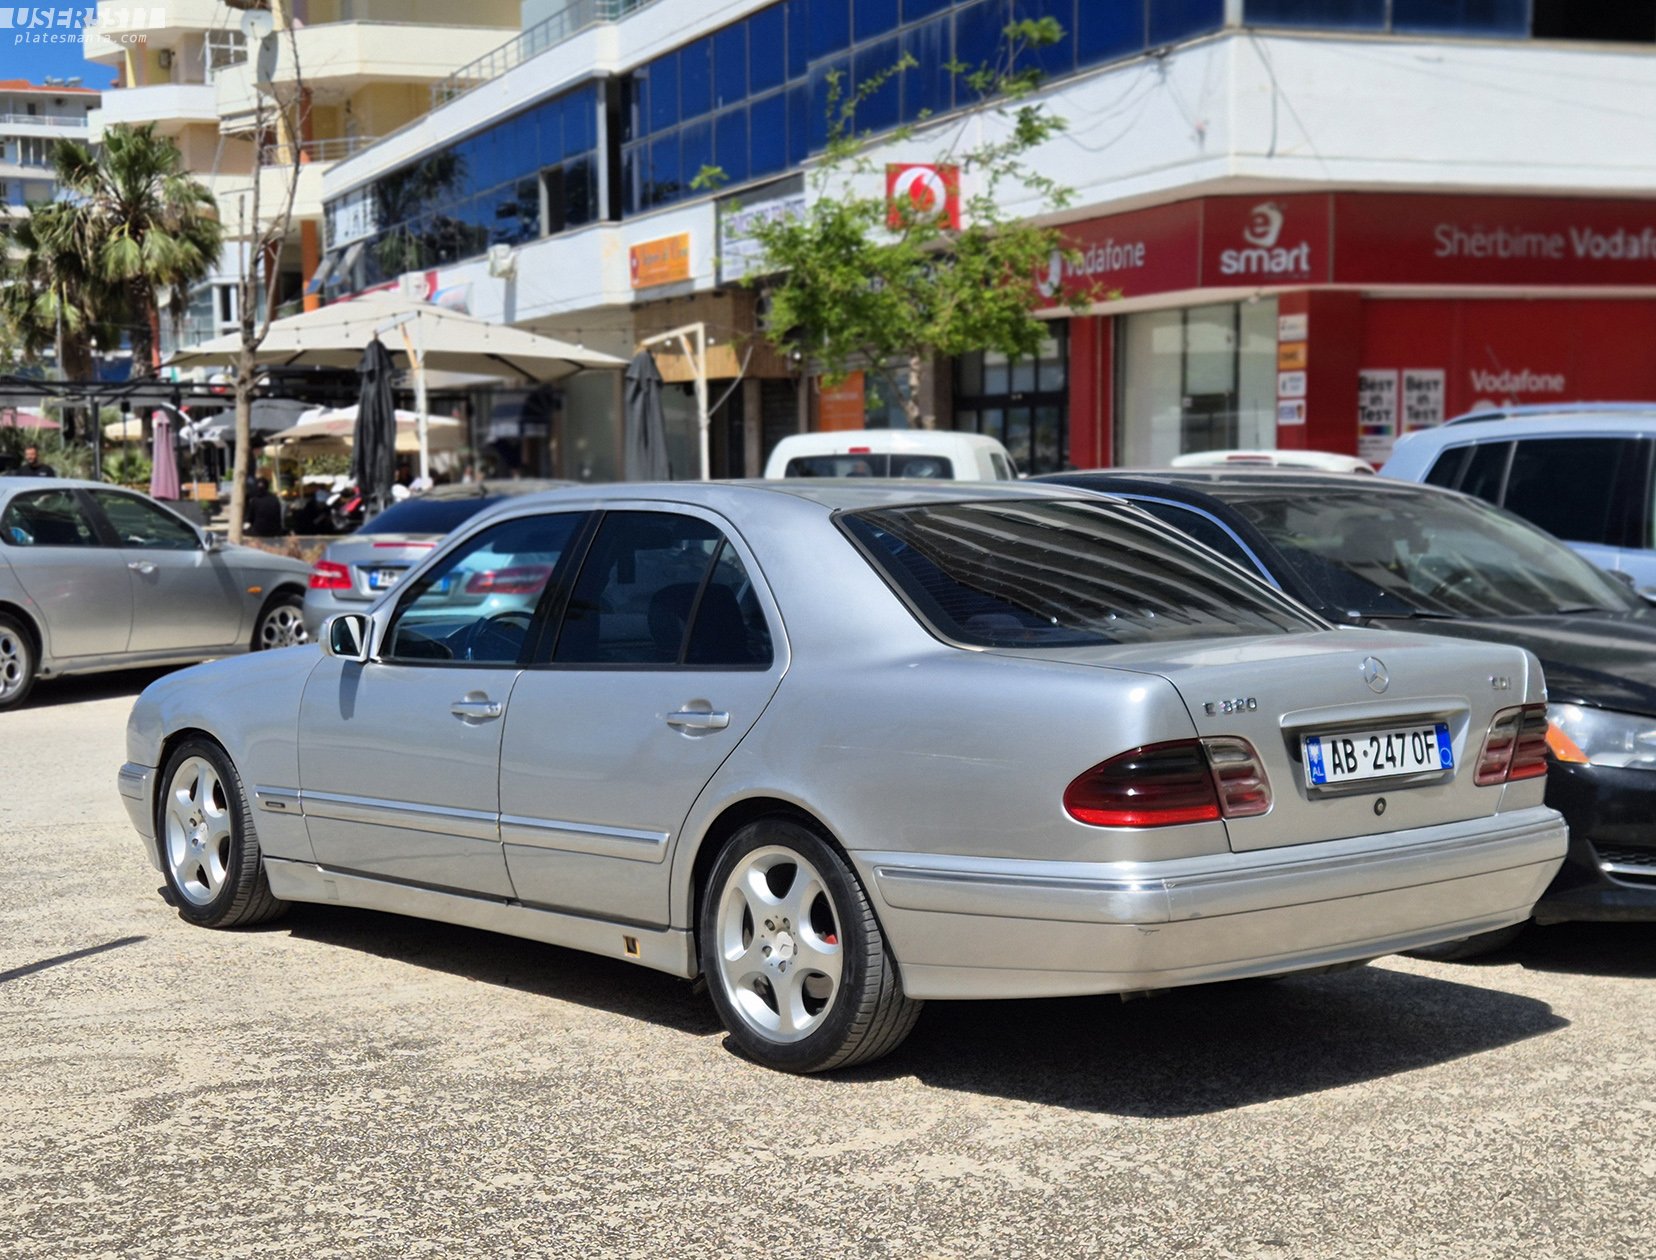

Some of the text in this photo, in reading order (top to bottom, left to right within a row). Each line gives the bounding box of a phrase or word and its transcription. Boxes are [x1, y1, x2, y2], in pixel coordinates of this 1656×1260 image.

[1434, 222, 1564, 258] Shërbime
[1219, 240, 1310, 275] smart
[1470, 367, 1566, 394] Vodafone
[1312, 766, 1325, 776] AL
